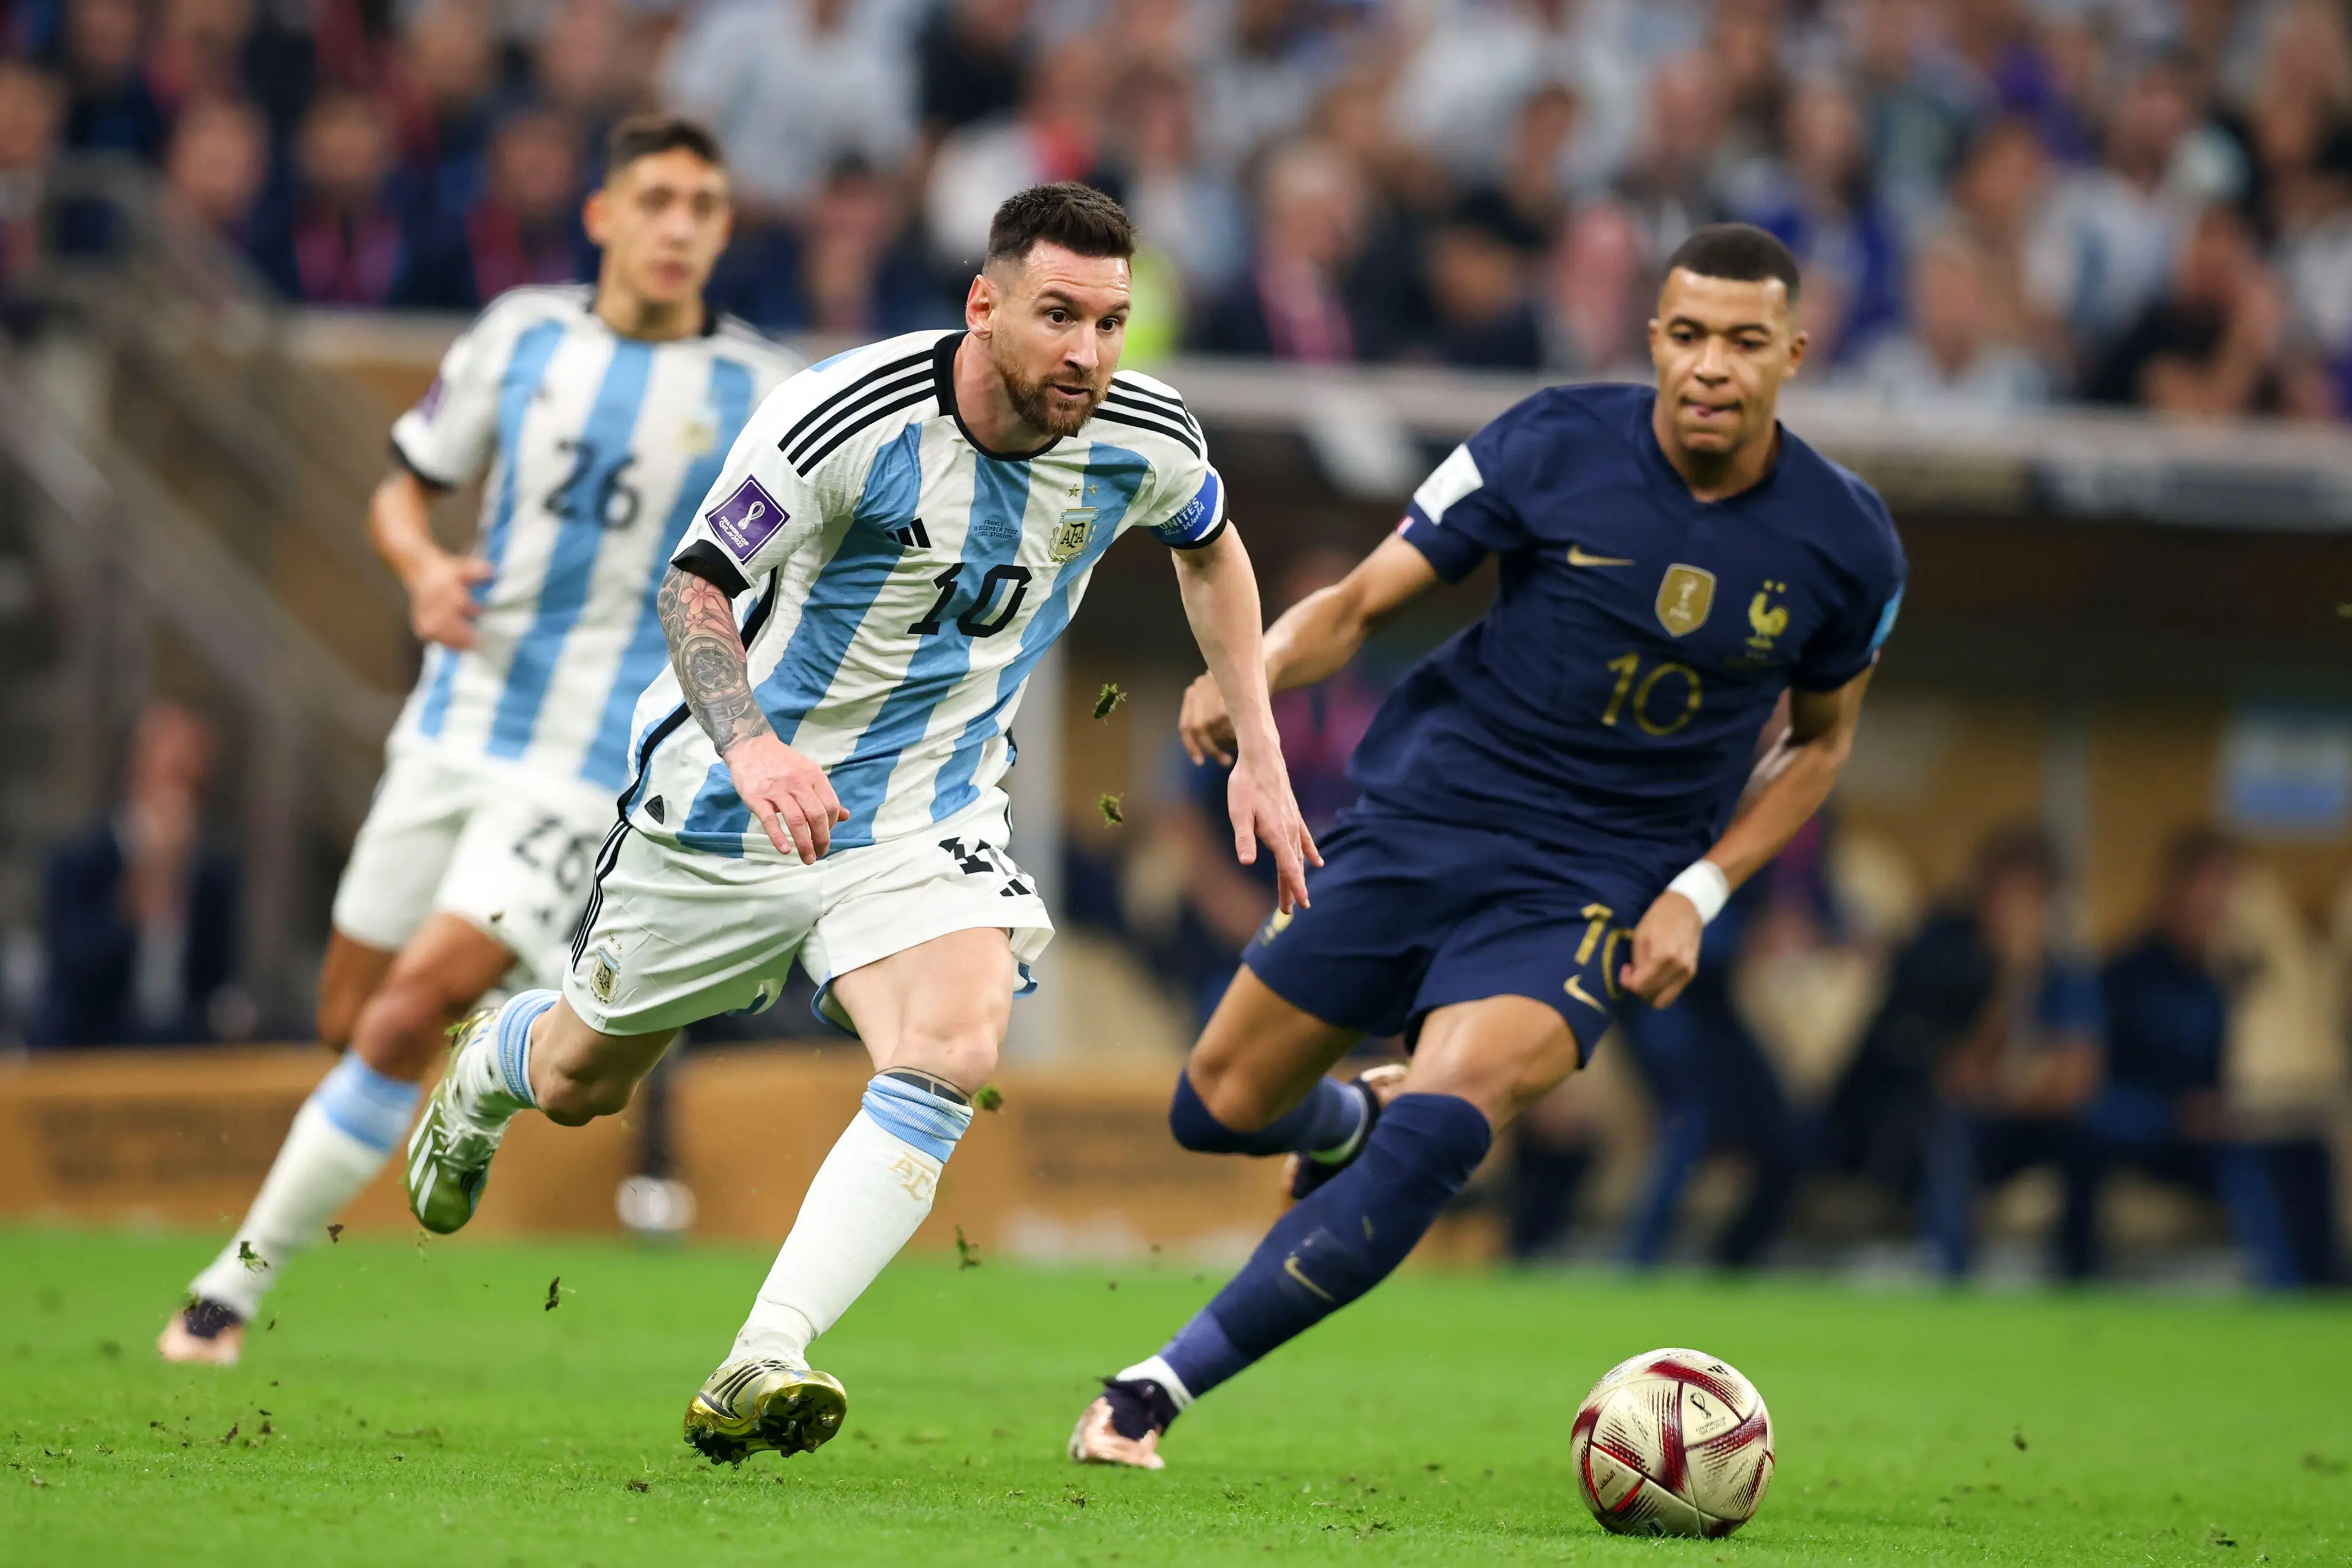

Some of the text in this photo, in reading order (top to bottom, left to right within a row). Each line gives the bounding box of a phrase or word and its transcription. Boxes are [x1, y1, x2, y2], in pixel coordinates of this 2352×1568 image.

[543, 438, 643, 529] 26
[1158, 497, 1199, 529] UNITES
[1182, 502, 1205, 530] World
[720, 516, 749, 546] FIFA WORLD CUP
[1060, 522, 1085, 549] AFA
[907, 562, 1033, 638] 10
[1600, 651, 1703, 736] 10
